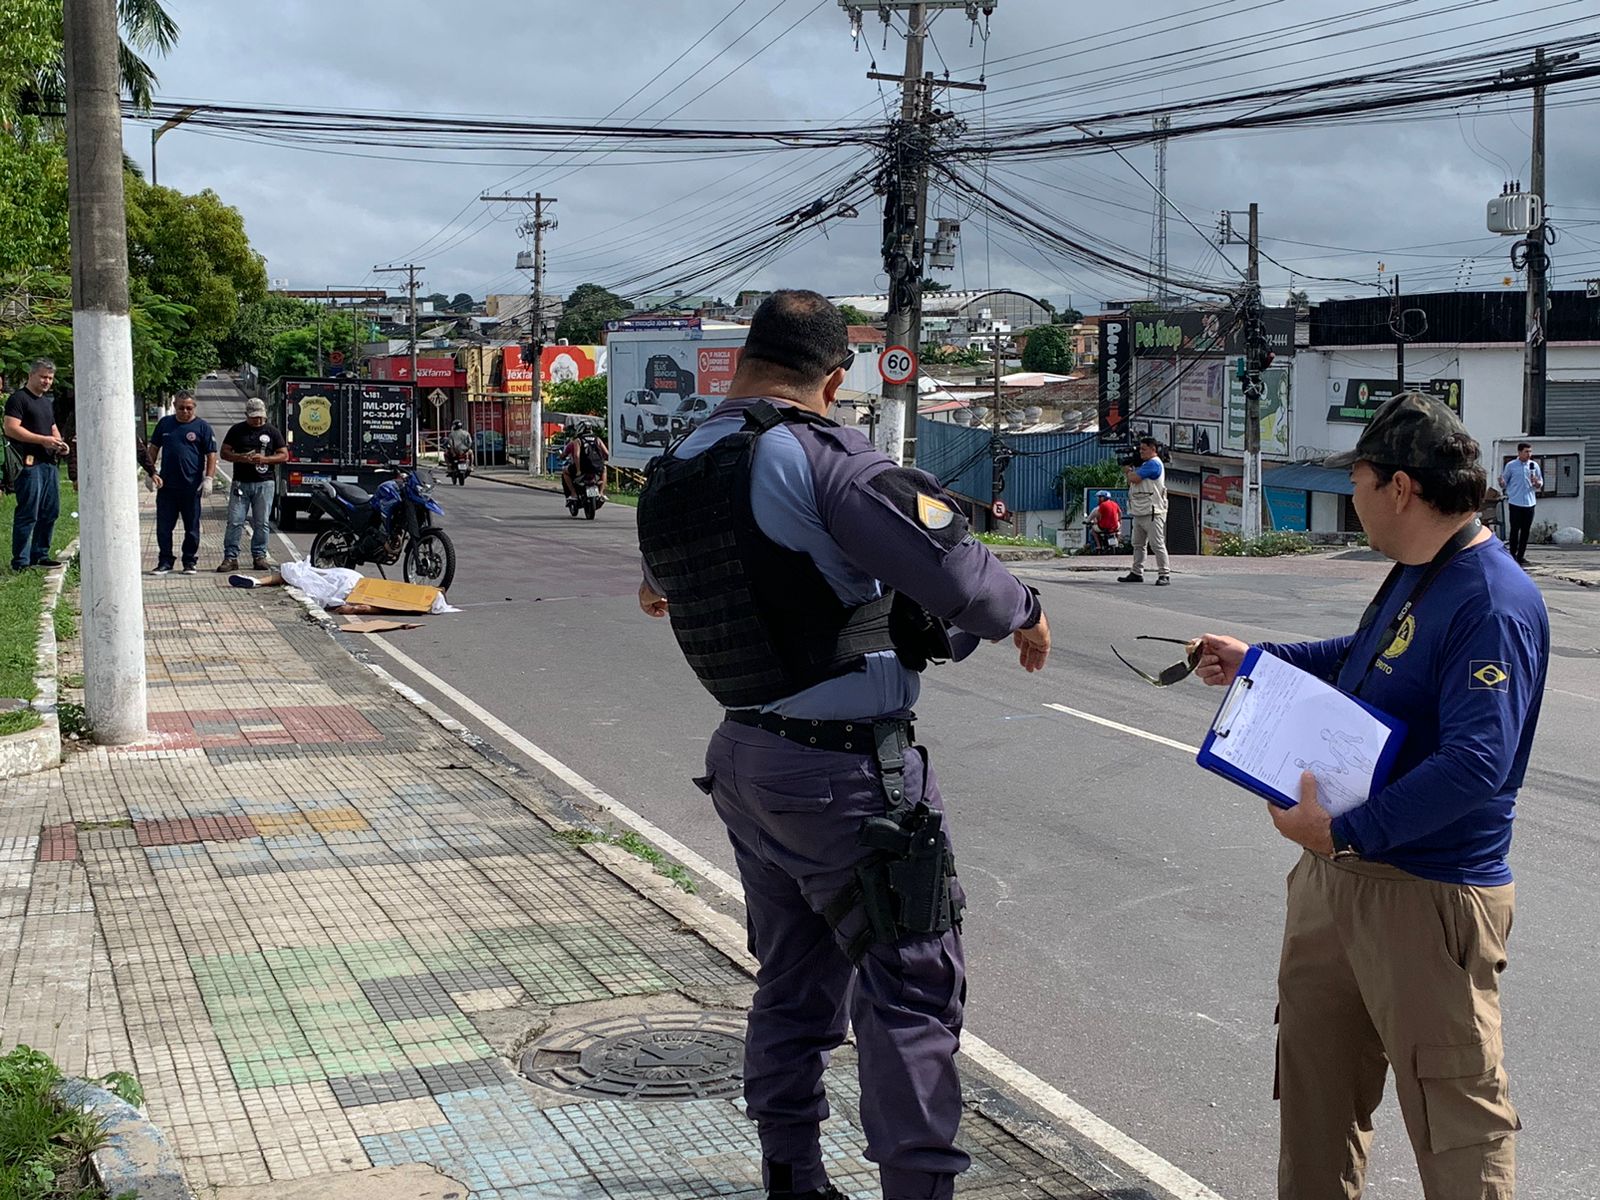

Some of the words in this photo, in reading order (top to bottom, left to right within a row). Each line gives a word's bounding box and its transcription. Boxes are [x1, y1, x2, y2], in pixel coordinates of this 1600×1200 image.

[1106, 323, 1122, 355] Pet
[1135, 321, 1154, 348] Pet
[1155, 319, 1182, 352] Shop
[887, 354, 910, 371] 60
[362, 401, 406, 411] IML-DPTC
[362, 411, 405, 419] PC-33.447
[373, 432, 398, 441] AMAZONAS
[1397, 601, 1412, 620] EOS
[1375, 658, 1393, 675] ERITO
